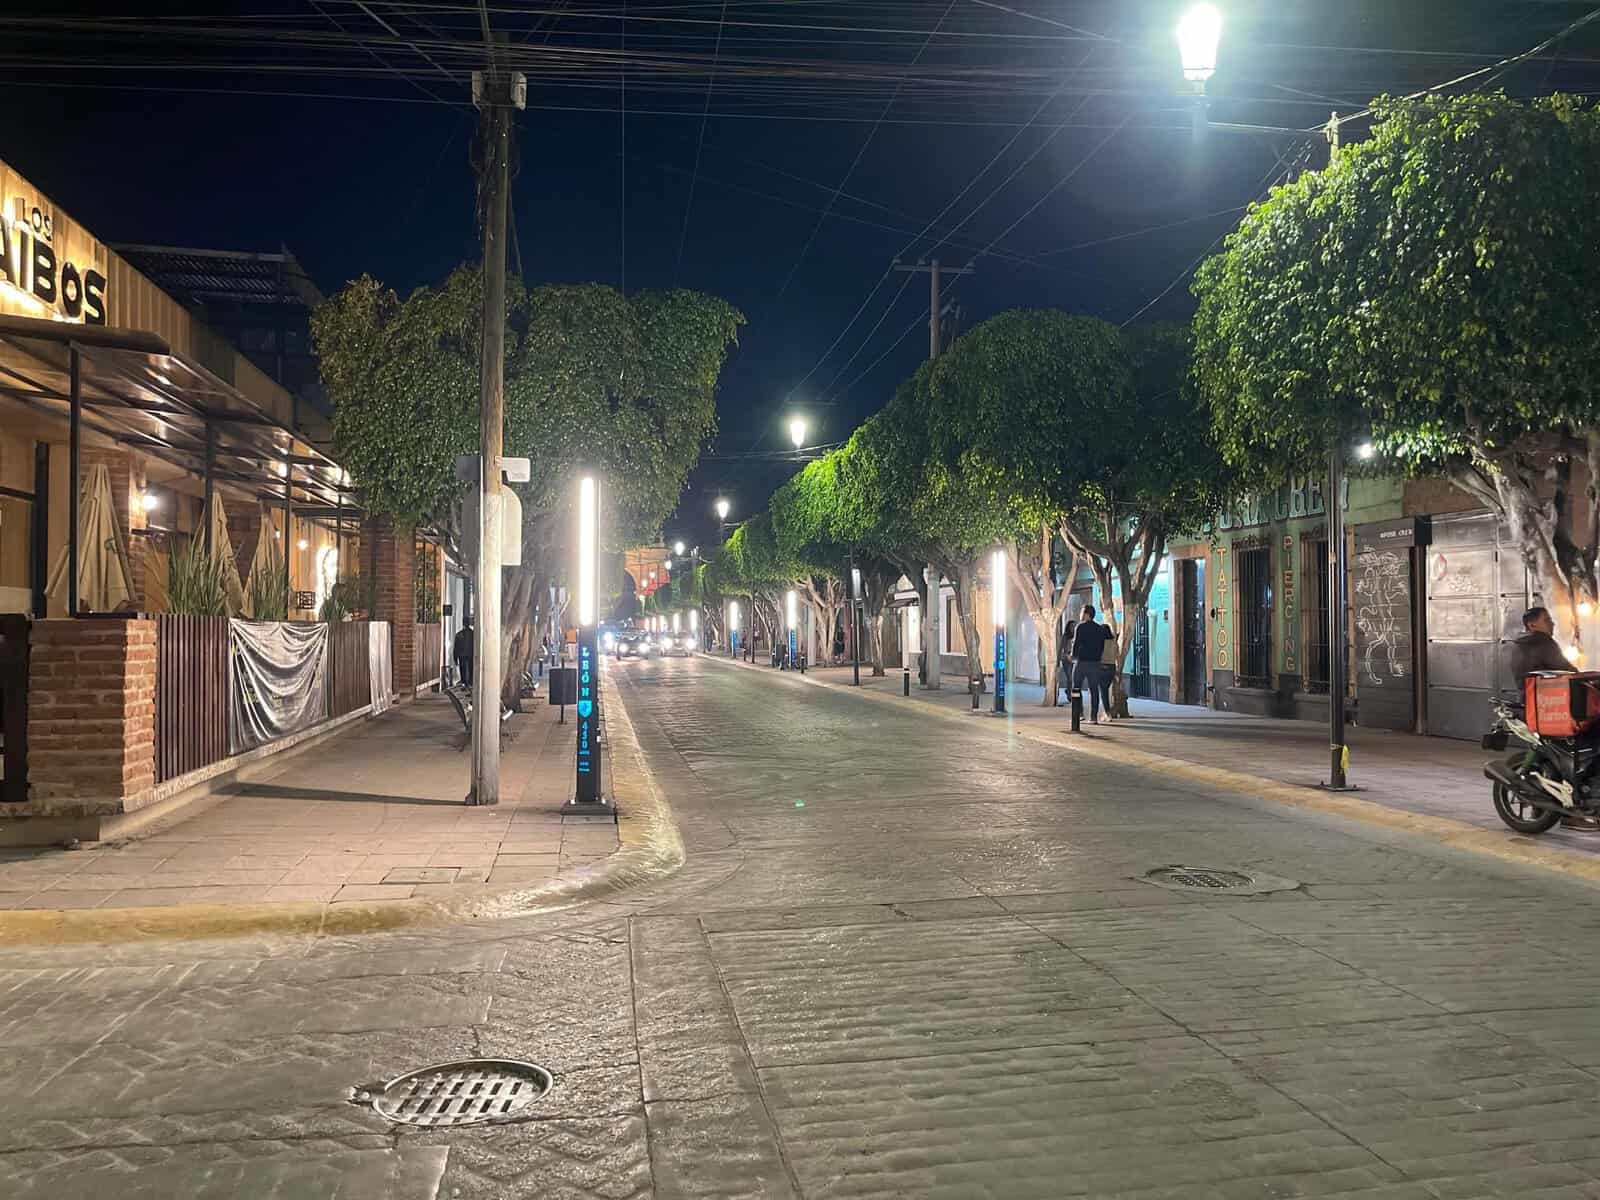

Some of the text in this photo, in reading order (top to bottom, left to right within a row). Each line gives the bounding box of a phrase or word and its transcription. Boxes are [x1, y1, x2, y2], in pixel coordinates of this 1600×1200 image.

[15, 197, 54, 242] LOS
[1216, 548, 1228, 667] TATTOO
[1283, 535, 1296, 671] PIERCING
